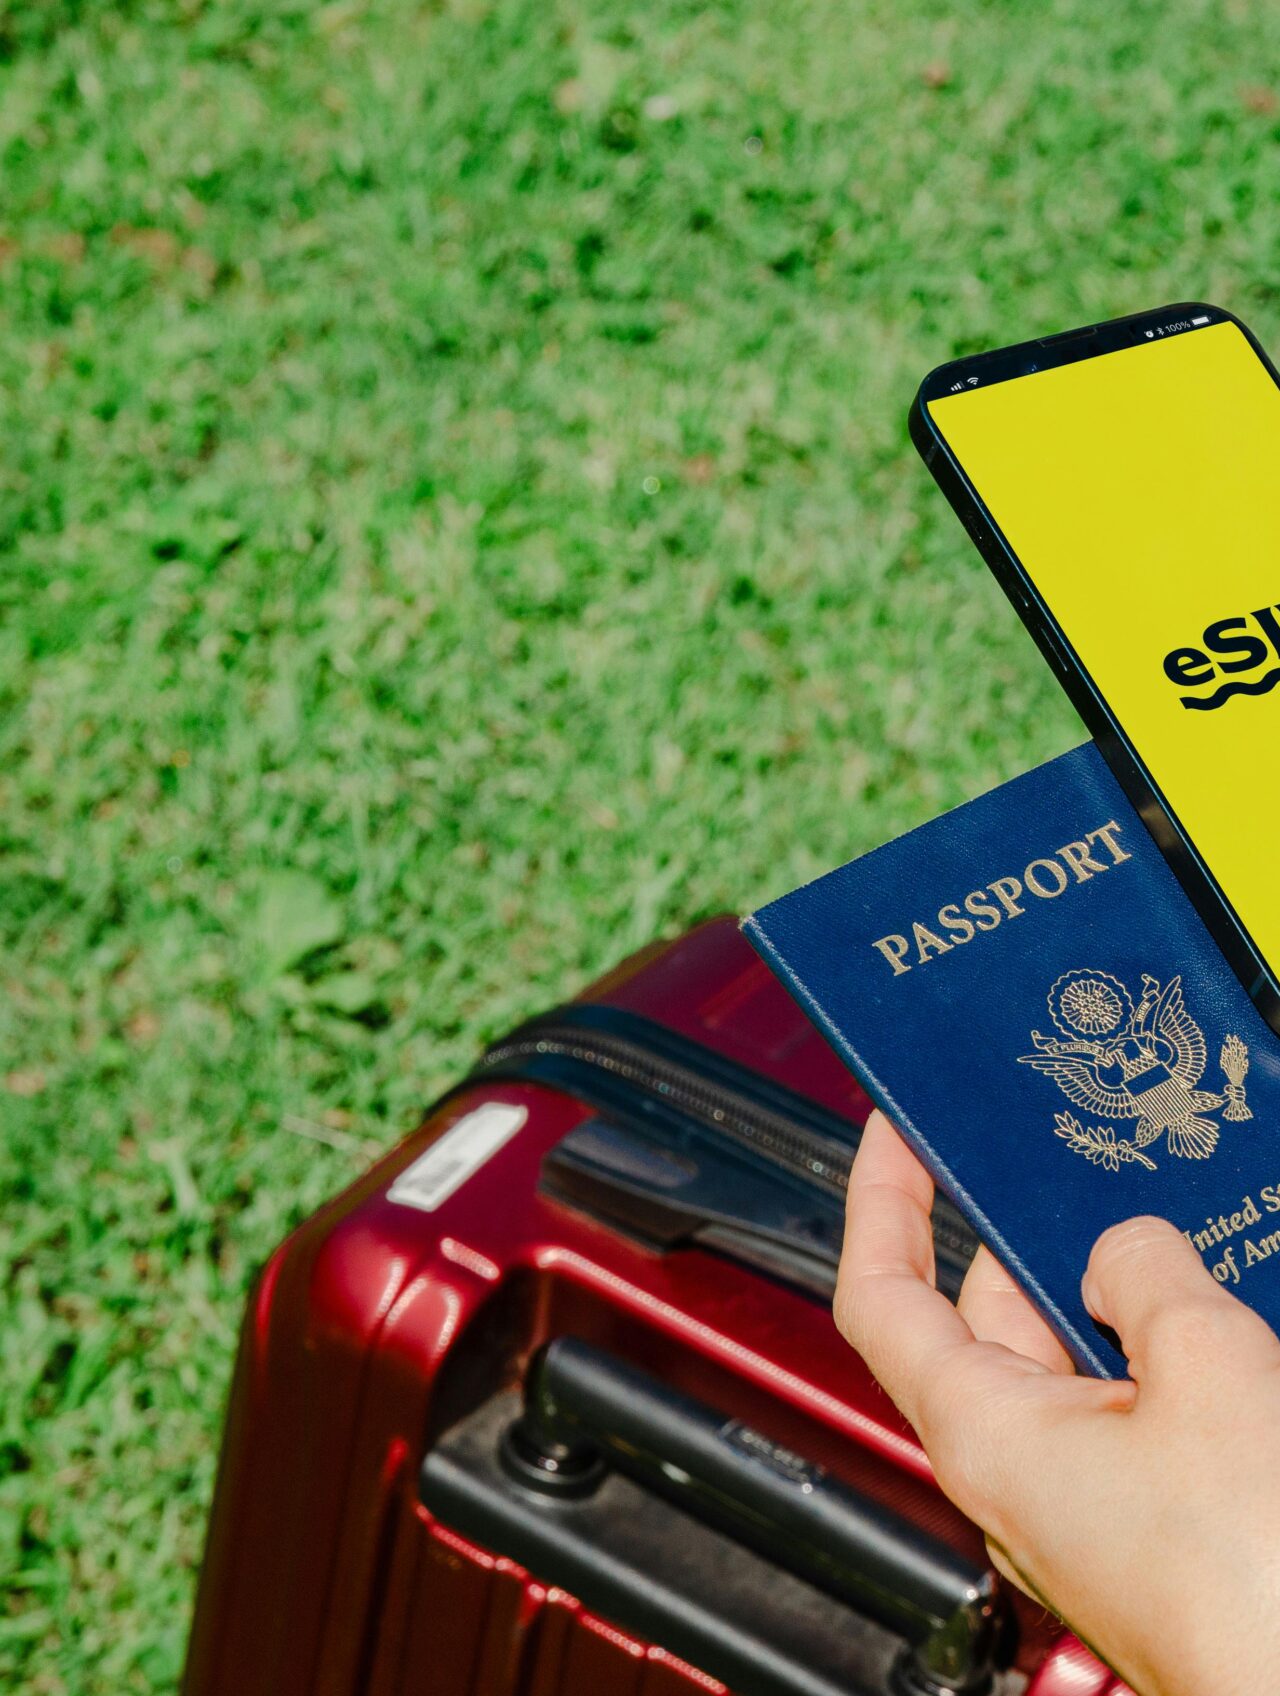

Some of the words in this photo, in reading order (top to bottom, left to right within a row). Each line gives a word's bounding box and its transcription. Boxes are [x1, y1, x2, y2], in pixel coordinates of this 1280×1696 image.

[1165, 321, 1191, 333] 100%
[872, 820, 1132, 976] PASSPORT
[1212, 1246, 1241, 1284] of
